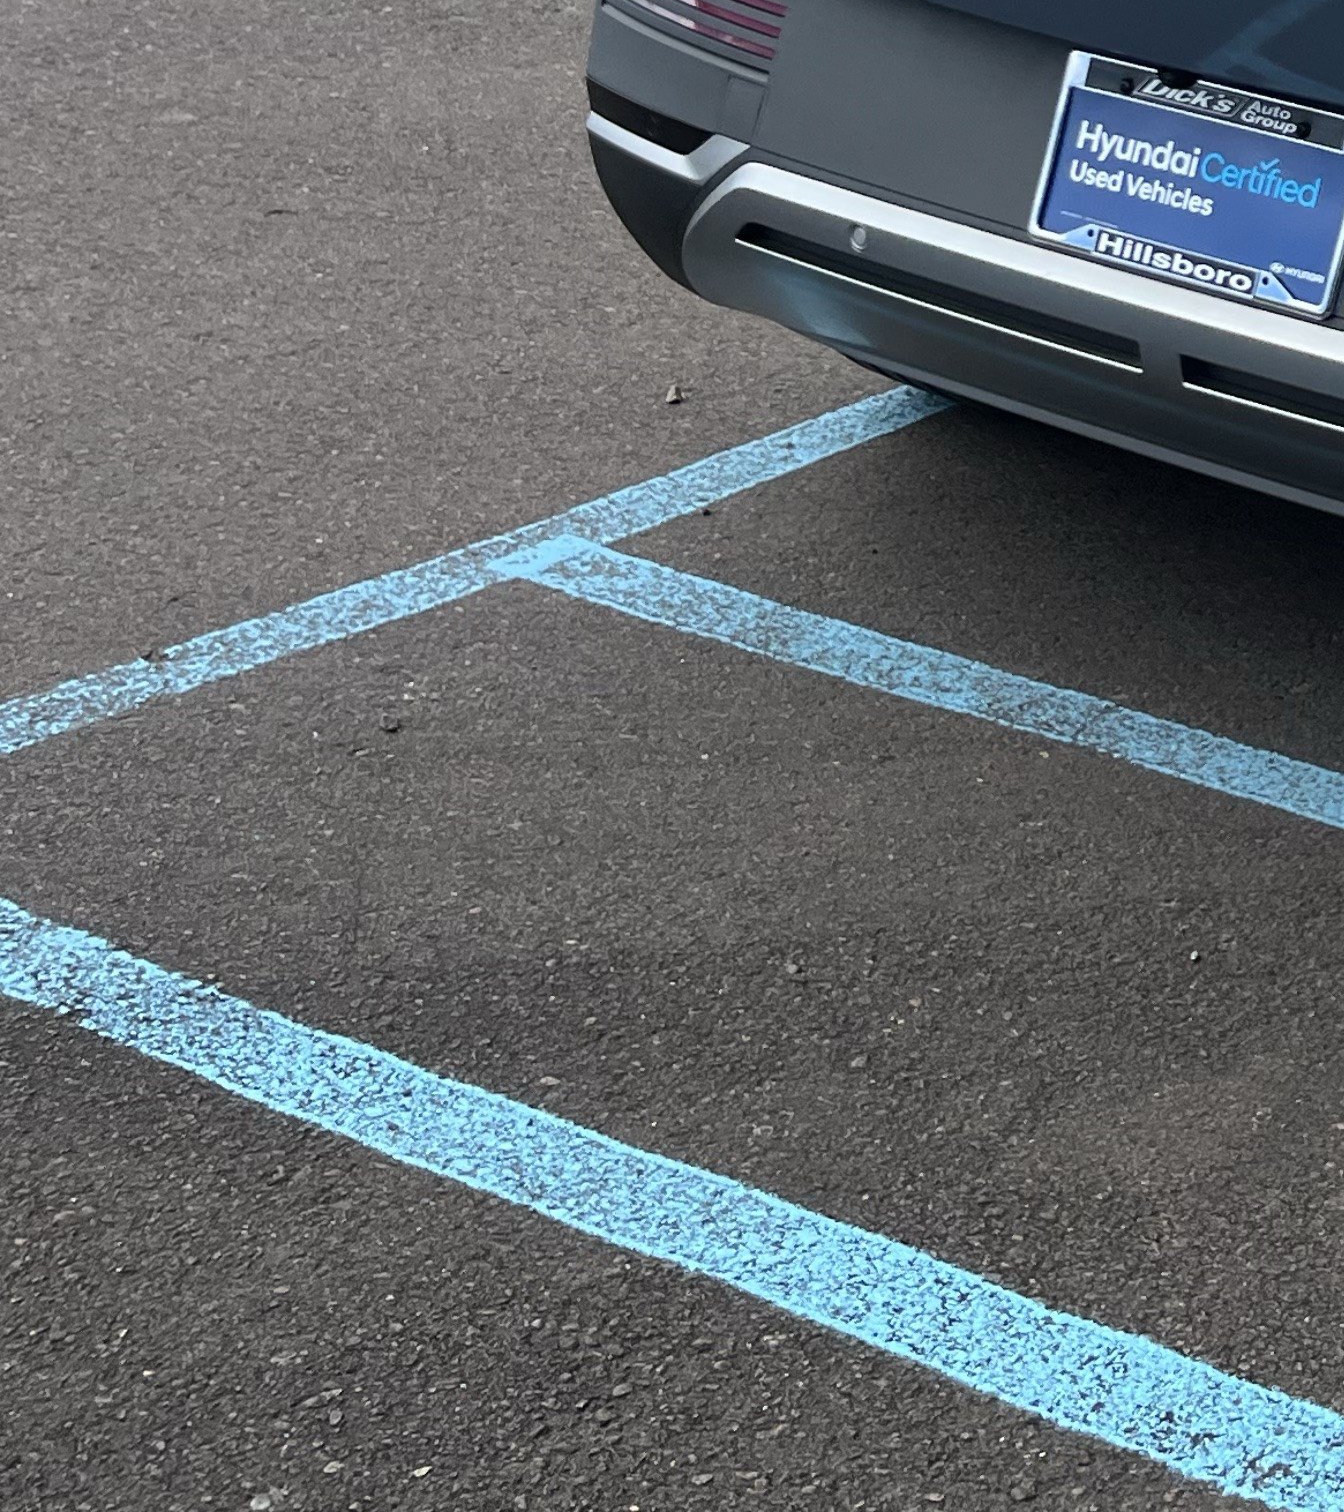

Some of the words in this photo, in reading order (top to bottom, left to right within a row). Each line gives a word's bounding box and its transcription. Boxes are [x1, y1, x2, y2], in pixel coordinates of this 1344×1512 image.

[1141, 78, 1237, 114] Dick's
[1247, 99, 1292, 120] Auto
[1240, 109, 1298, 135] Group
[1075, 119, 1202, 179] Hyundai
[1199, 151, 1322, 209] Certified
[1069, 159, 1122, 194] Used
[1126, 171, 1215, 217] Vehicles
[1096, 231, 1253, 293] Hillsboro
